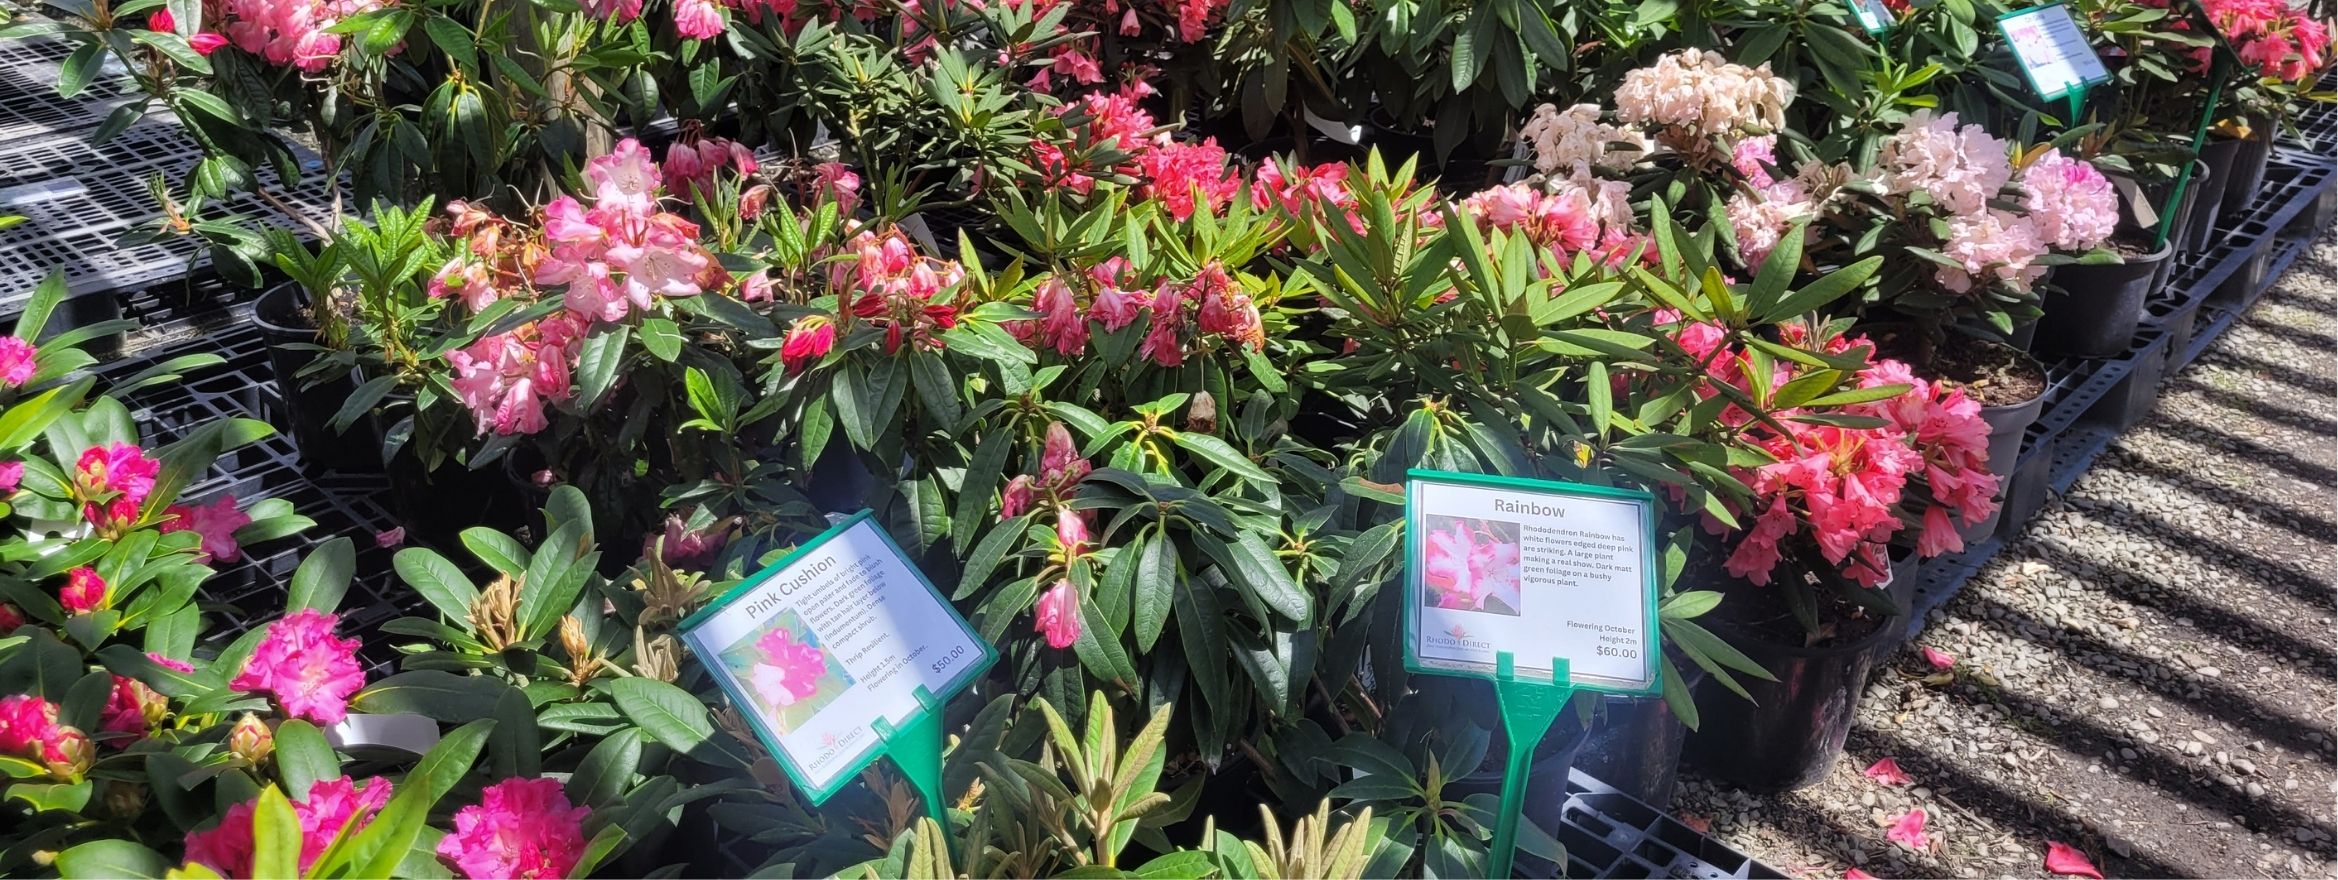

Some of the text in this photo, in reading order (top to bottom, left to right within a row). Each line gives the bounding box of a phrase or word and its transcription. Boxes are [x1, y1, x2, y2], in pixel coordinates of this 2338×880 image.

[1494, 497, 1565, 518] Rainbow
[1523, 524, 1625, 542] Rhododendron Rainbow has
[1523, 534, 1633, 553] white flowers edged deep pink
[1523, 554, 1550, 565] making
[1572, 559, 1594, 569] show.
[1595, 562, 1613, 571] Dark
[1614, 564, 1632, 573] matt
[1536, 545, 1566, 556] striking.
[1574, 549, 1593, 560] large
[1594, 551, 1613, 561] plant
[794, 553, 872, 608] Tight umbels of bright pink
[1523, 565, 1545, 574] green
[1545, 566, 1571, 577] foliage
[1589, 571, 1612, 582] bushy
[1523, 574, 1578, 587] vigorous plant.
[744, 554, 837, 620] Pink Cushion
[802, 558, 883, 616] open paler and fade to blush
[808, 569, 885, 625] flowers. Dark green foliage
[815, 581, 887, 633] with tan hair layer below
[865, 594, 886, 610] Dense
[831, 613, 878, 650] compact shrub.
[1566, 620, 1635, 634] Flowering October
[844, 631, 890, 667] Thrip Resilient.
[1599, 634, 1624, 645] Height
[930, 644, 966, 674] $50.00
[1596, 644, 1637, 659] $60.00
[858, 653, 896, 684] Height 1.5m
[866, 642, 929, 692] Flowering in October.
